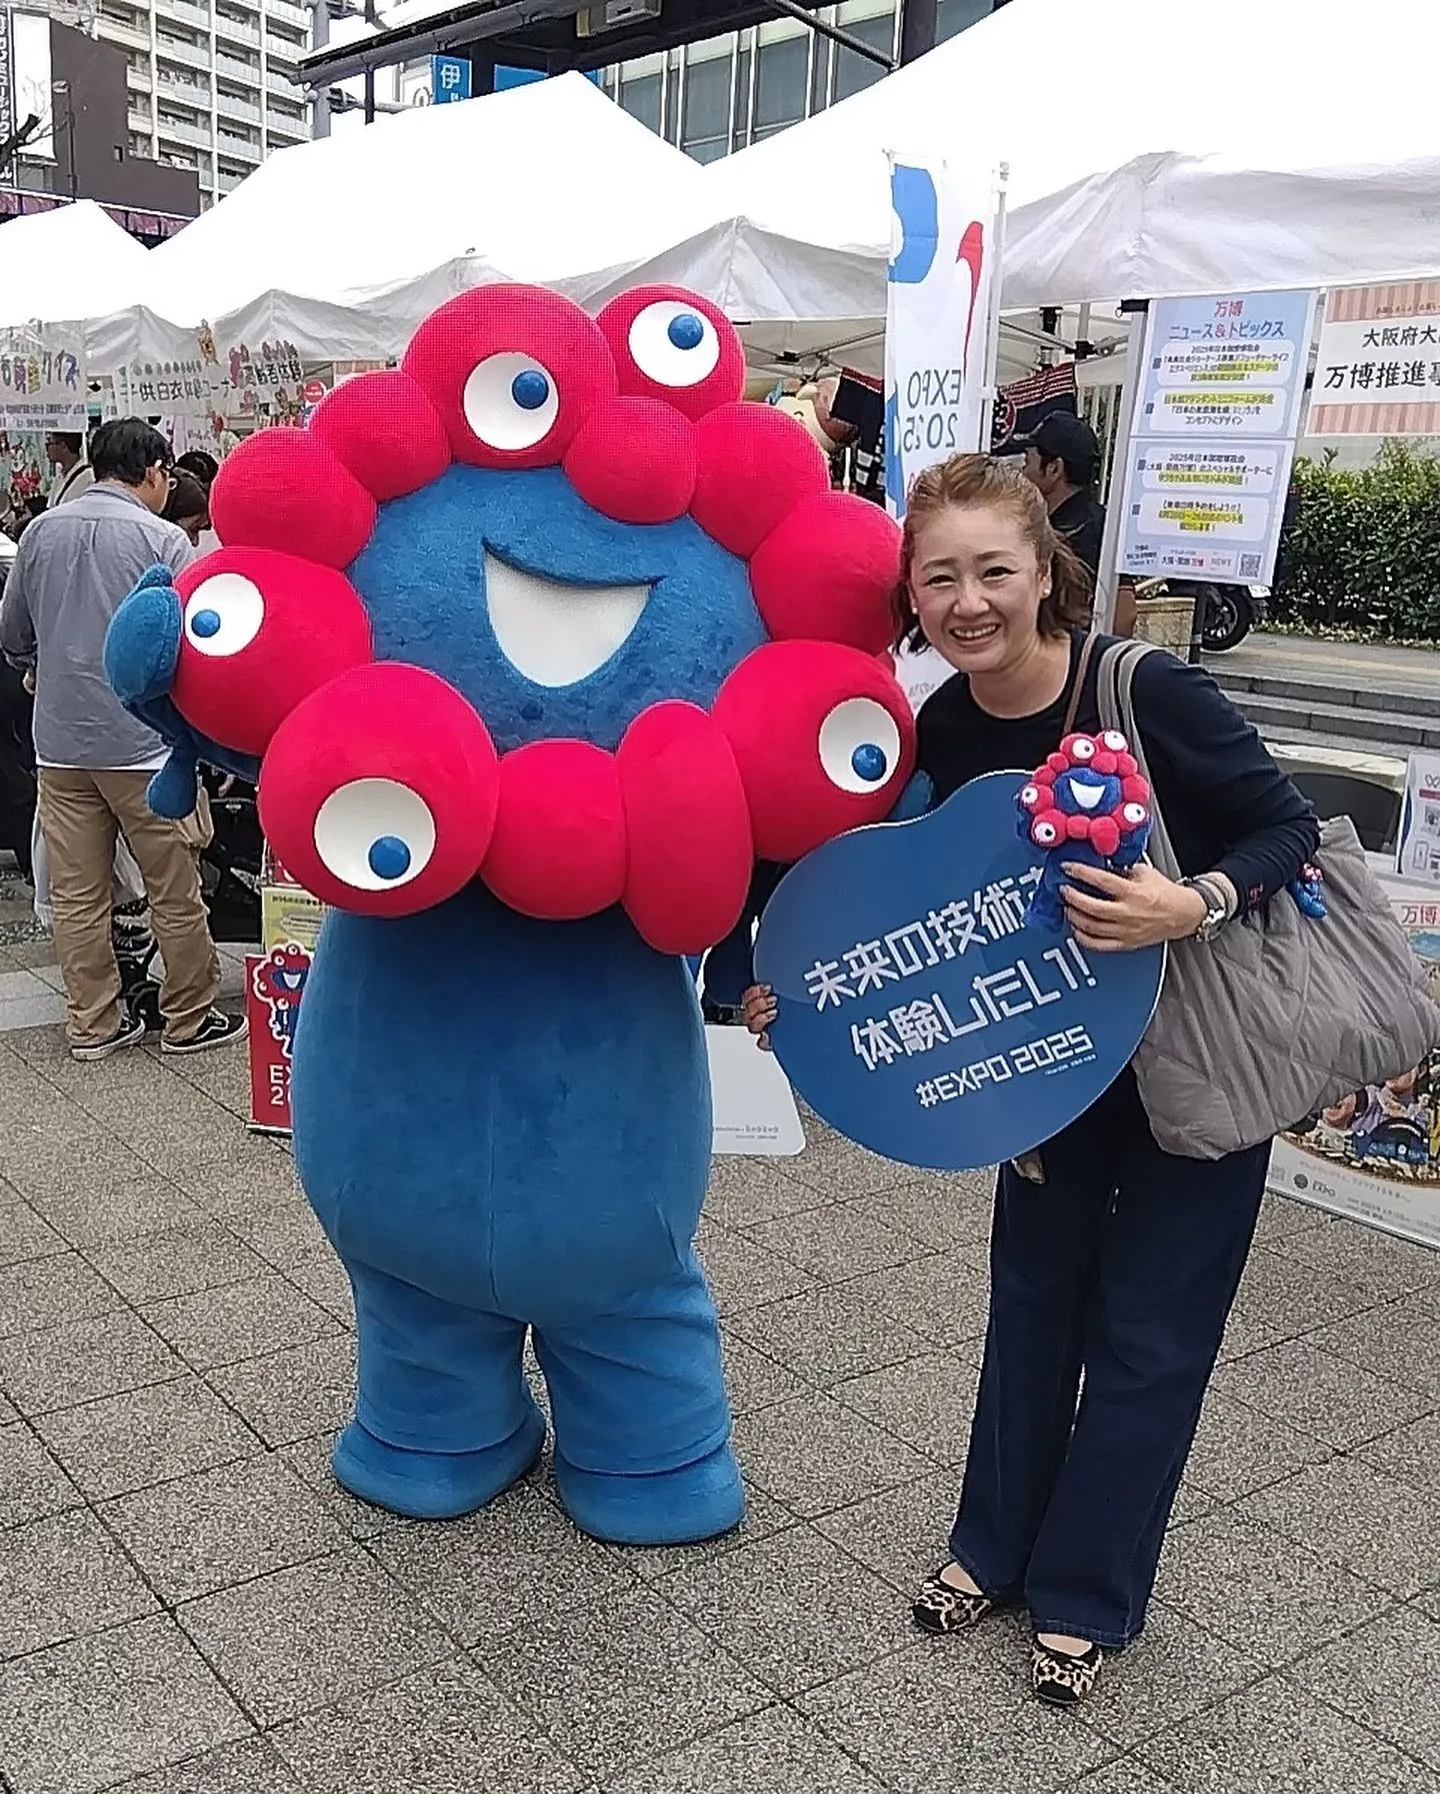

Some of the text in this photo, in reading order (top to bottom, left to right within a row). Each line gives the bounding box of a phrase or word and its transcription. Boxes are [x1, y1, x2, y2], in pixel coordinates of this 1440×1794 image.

[1213, 300, 1244, 318] 万博
[1361, 324, 1440, 348] 大阪府大
[915, 1055, 1013, 1108] #EXPO
[1009, 1025, 1095, 1075] 2025
[270, 1085, 292, 1106] 2
